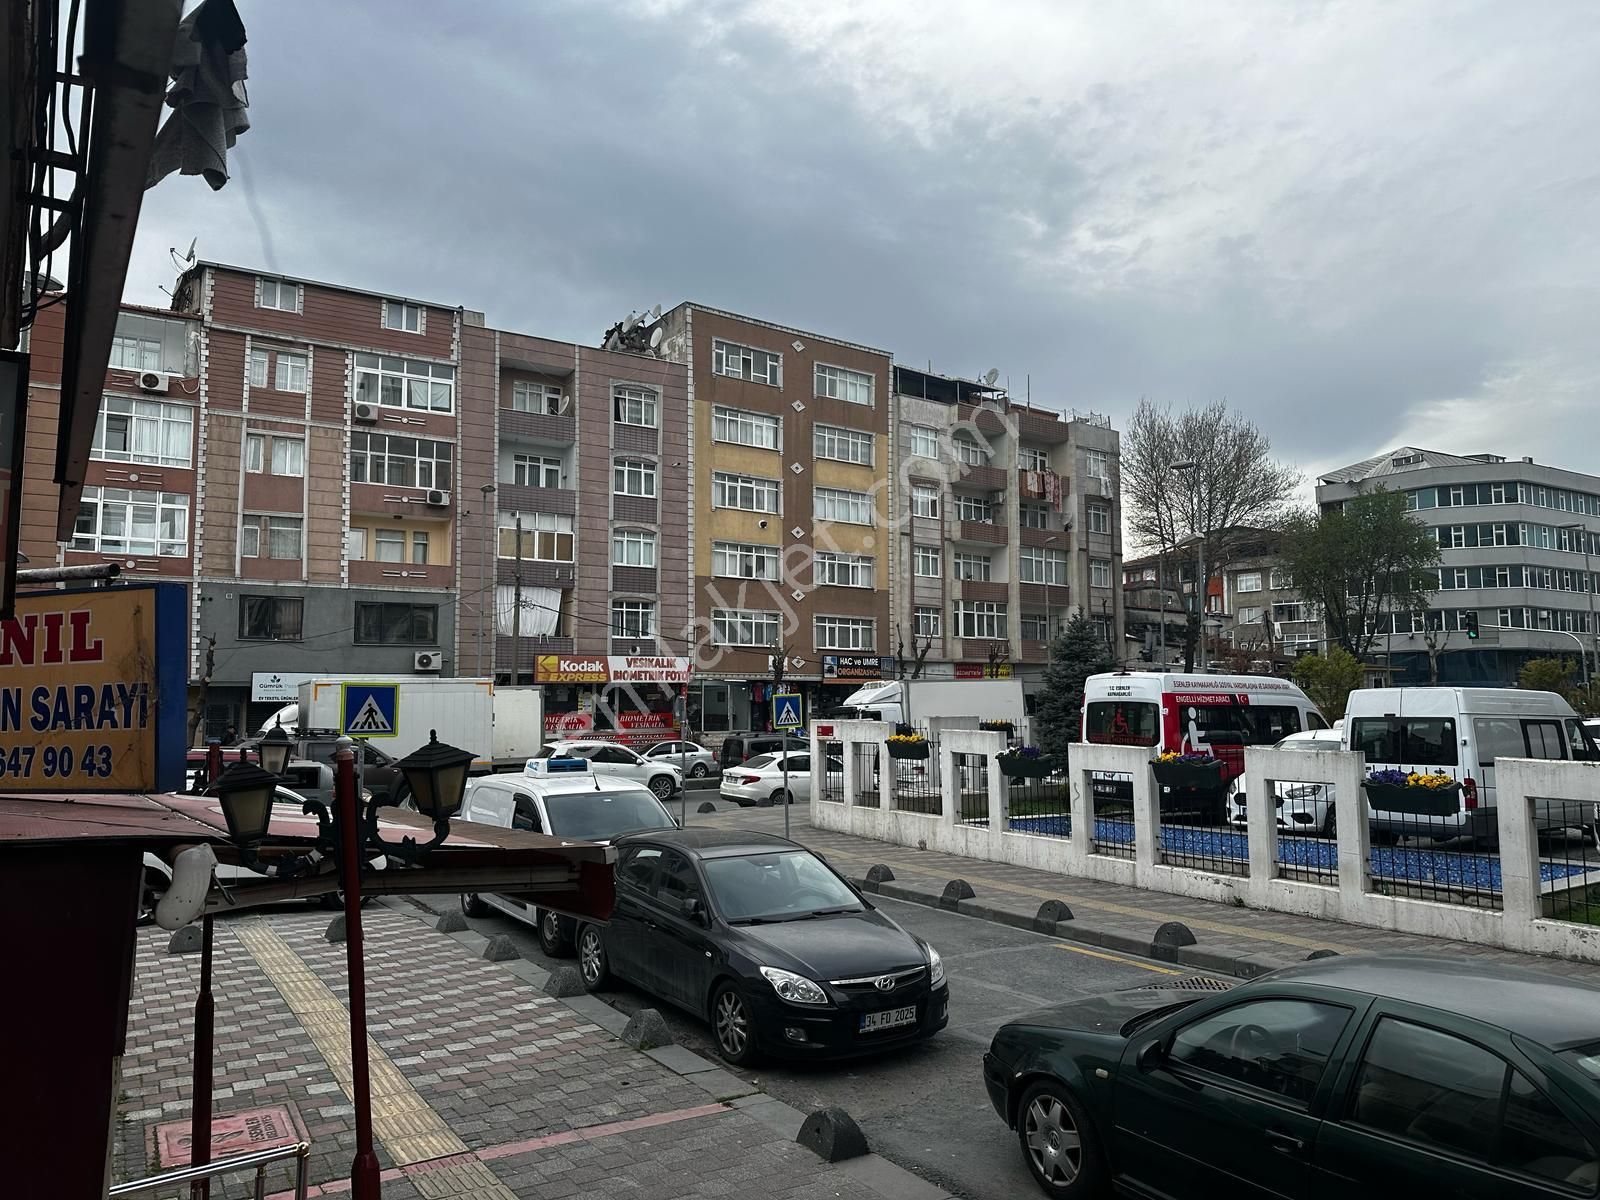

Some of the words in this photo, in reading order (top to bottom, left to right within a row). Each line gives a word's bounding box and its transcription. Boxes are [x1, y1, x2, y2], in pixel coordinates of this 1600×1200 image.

[560, 660, 604, 672] Kodak
[839, 657, 853, 666] HAC
[862, 658, 879, 666] UMRE
[549, 673, 607, 682] EXPRESS
[666, 670, 688, 682] FOTO
[30, 682, 149, 732] SARAYI
[43, 745, 74, 778] 90
[80, 745, 112, 778] 43
[865, 1015, 876, 1027] 34
[895, 1007, 914, 1021] 2025
